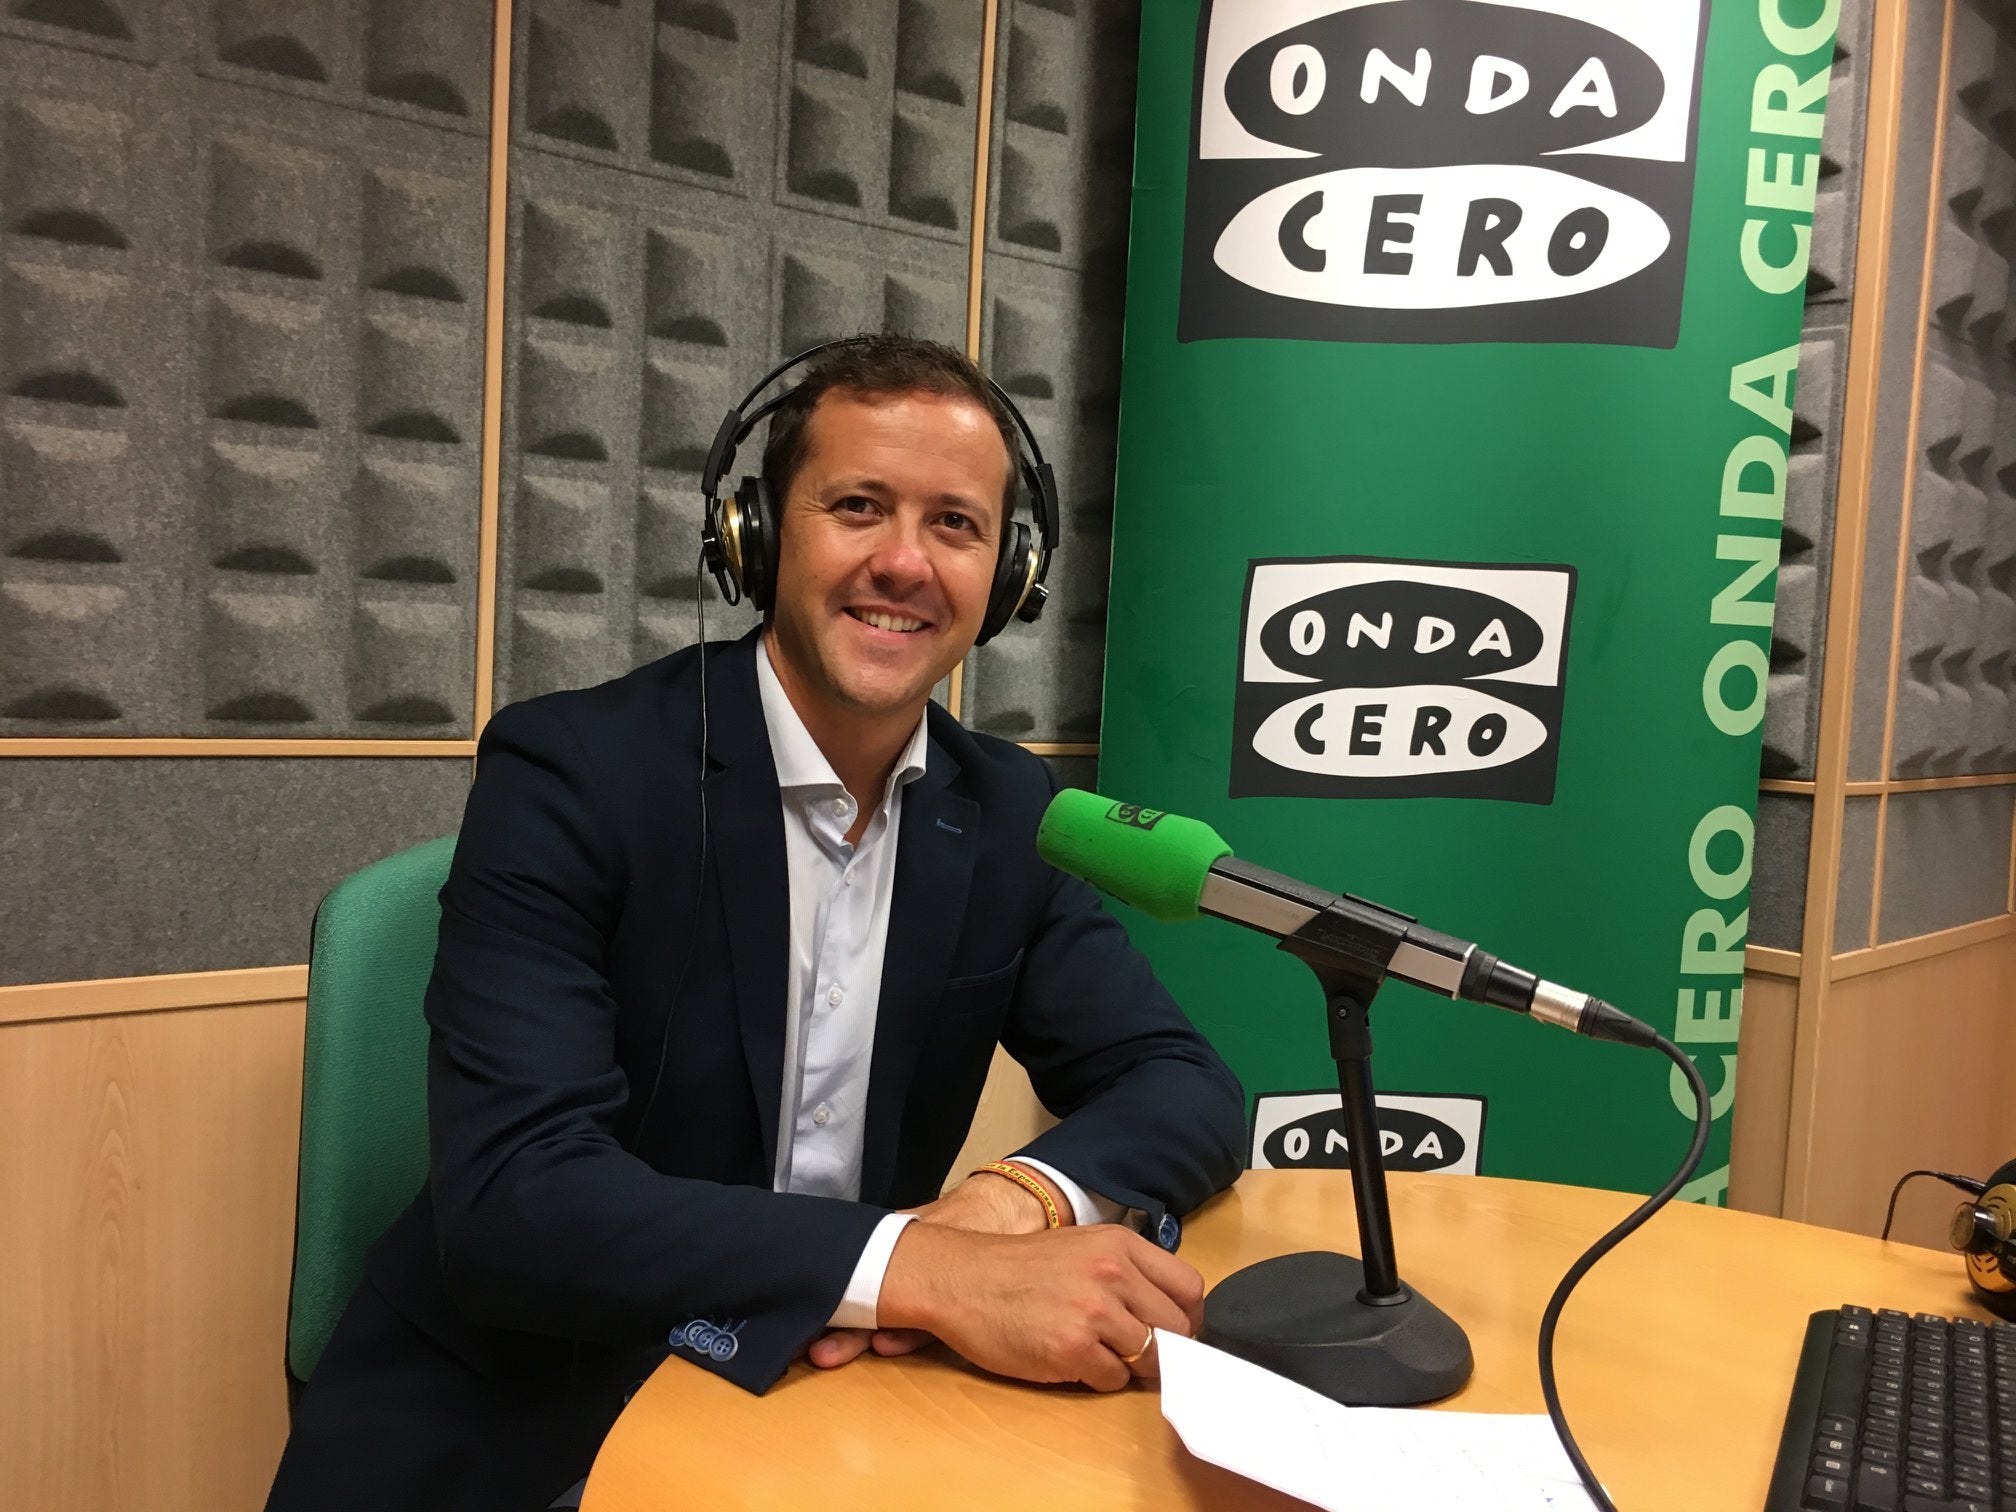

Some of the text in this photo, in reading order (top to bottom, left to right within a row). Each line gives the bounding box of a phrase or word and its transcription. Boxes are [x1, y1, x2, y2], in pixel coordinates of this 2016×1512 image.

[1269, 43, 1619, 119] ONDA
[1277, 189, 1610, 278] CERO
[1702, 343, 1801, 736] ONDA
[1288, 609, 1513, 658] ONDA
[1294, 702, 1508, 757] CERO
[1669, 805, 1756, 1122] CERO
[1283, 1127, 1444, 1161] ONDA
